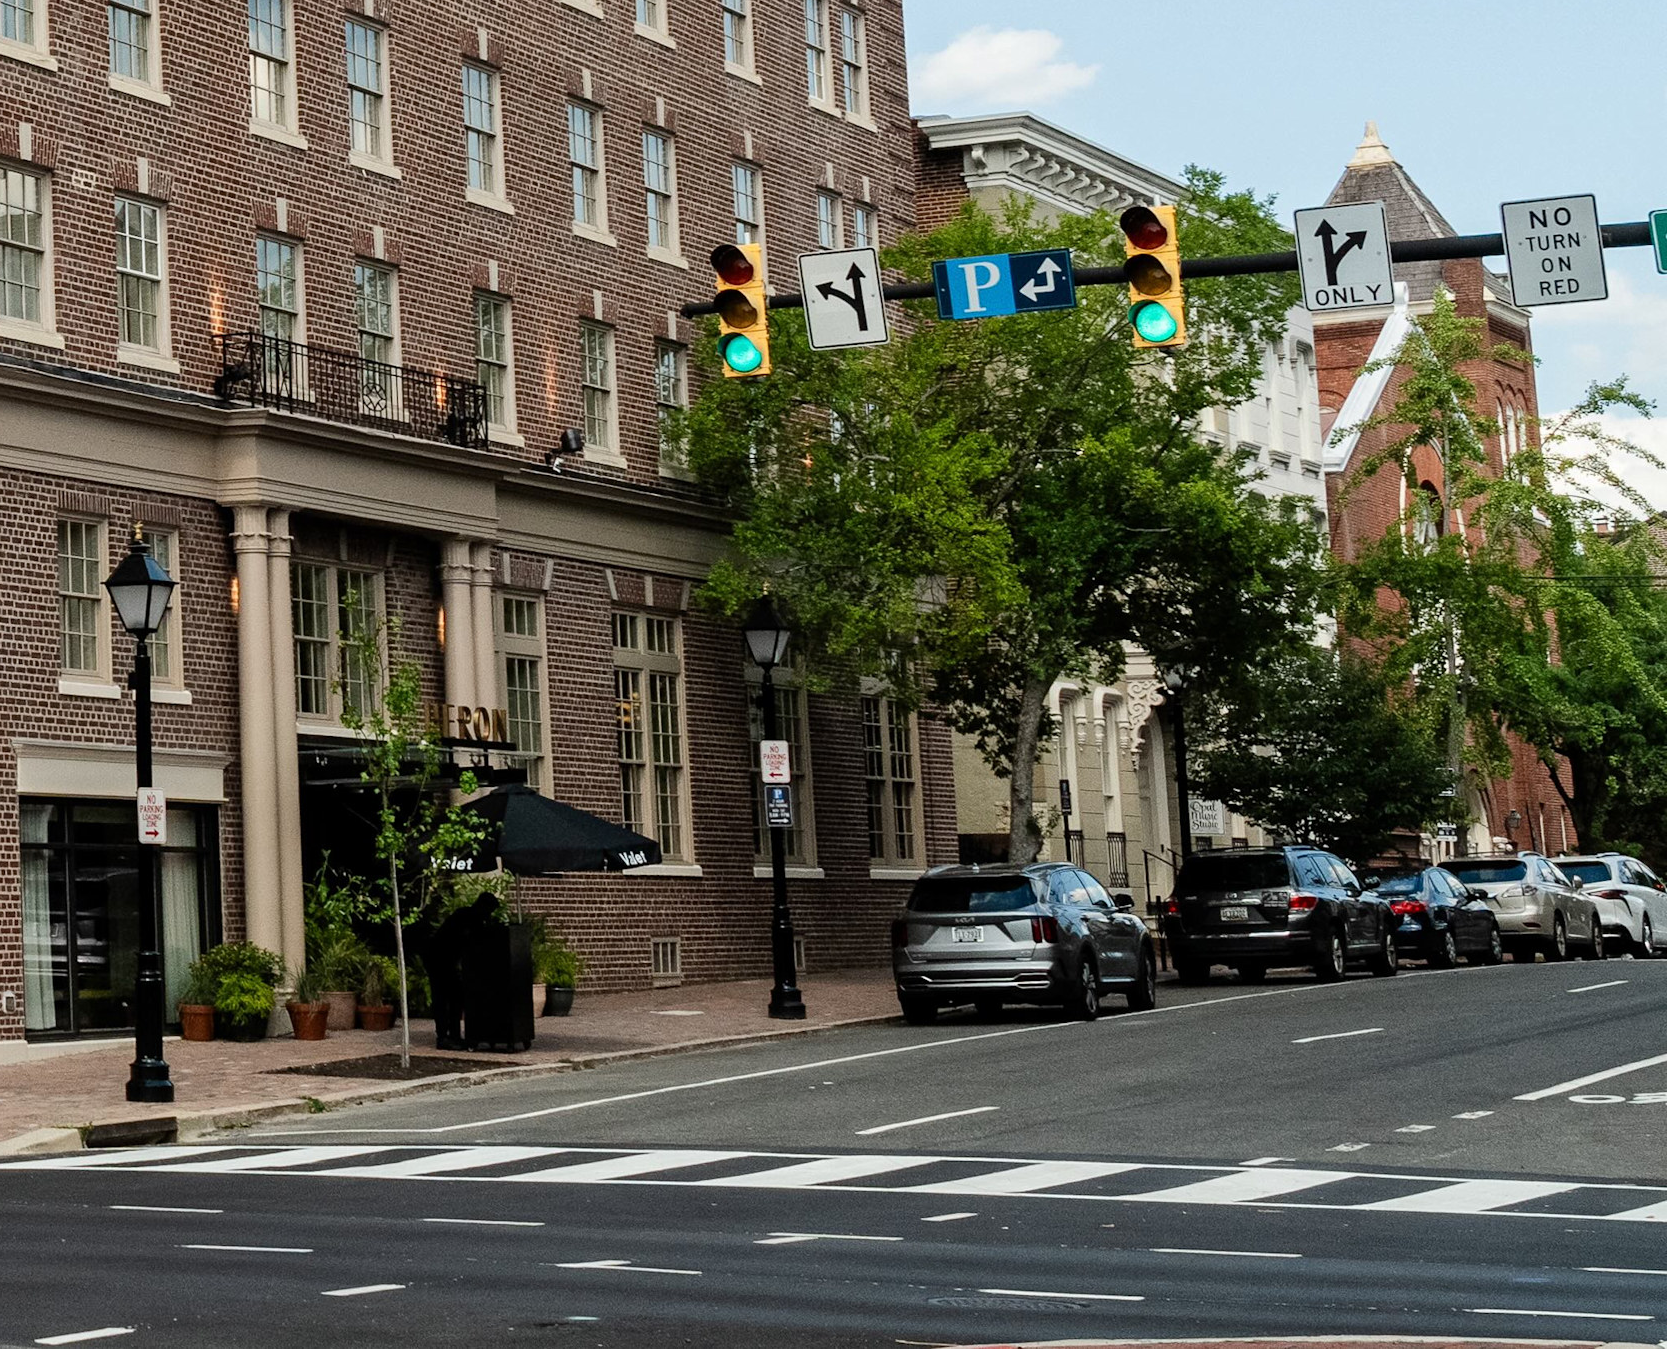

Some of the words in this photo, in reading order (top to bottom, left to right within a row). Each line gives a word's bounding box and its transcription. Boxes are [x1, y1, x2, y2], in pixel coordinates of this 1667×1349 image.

[1529, 207, 1572, 230] NO
[1525, 231, 1582, 253] TURN
[1541, 256, 1573, 273] ON
[957, 261, 1001, 313] P
[1539, 278, 1580, 297] RED
[1315, 283, 1382, 307] ONLY
[424, 699, 507, 743] HERON
[769, 745, 780, 753] NO
[146, 794, 157, 804] NO
[139, 805, 164, 814] PARKING
[1189, 801, 1218, 814] Opal
[142, 813, 162, 821] LOADING
[1191, 811, 1218, 820] Music
[1191, 820, 1219, 831] Studio
